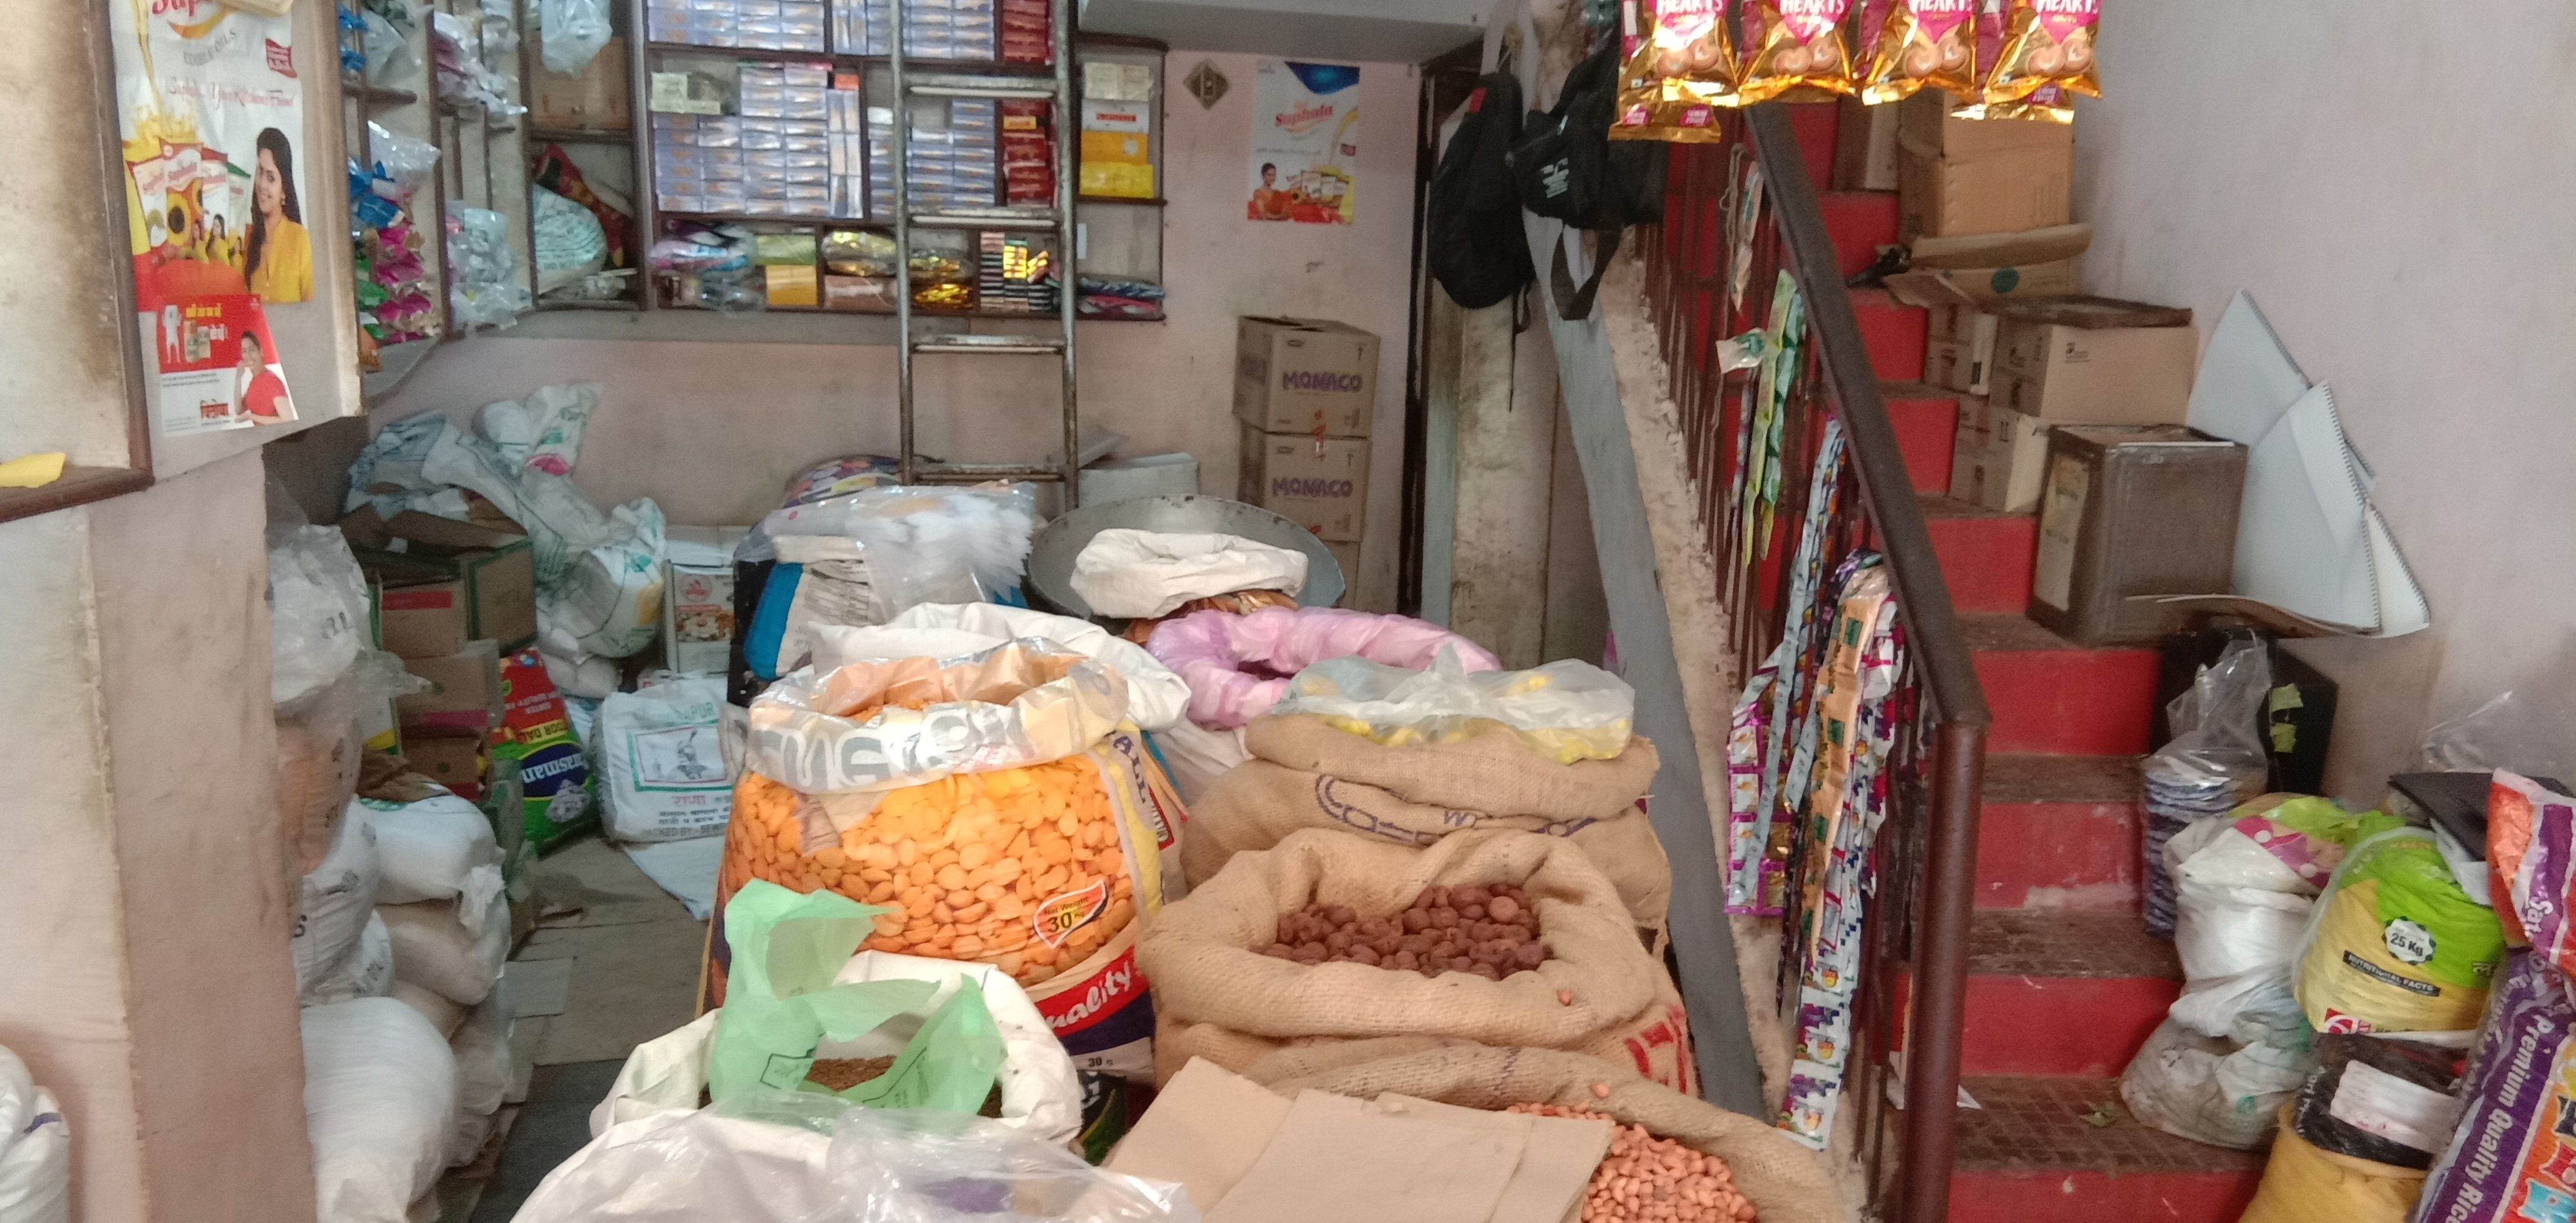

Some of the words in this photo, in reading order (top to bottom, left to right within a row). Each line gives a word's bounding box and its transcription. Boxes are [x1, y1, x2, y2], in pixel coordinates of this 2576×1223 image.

[1779, 0, 1844, 14] HEARTS
[1283, 372, 1363, 392] MONACO
[1272, 477, 1353, 497] MONACO
[520, 753, 586, 784] rasman
[1059, 895, 1089, 912] Weight
[1047, 912, 1072, 932] 30
[2390, 933, 2406, 948] 25
[2408, 940, 2424, 957] Kg
[2348, 953, 2401, 984] NUTRITIONAL
[2403, 978, 2434, 992] FACTS
[1045, 960, 1132, 1032] uality
[1088, 1057, 1102, 1067] 30
[2500, 1013, 2555, 1108] Premium
[2472, 1107, 2513, 1180] Quality
